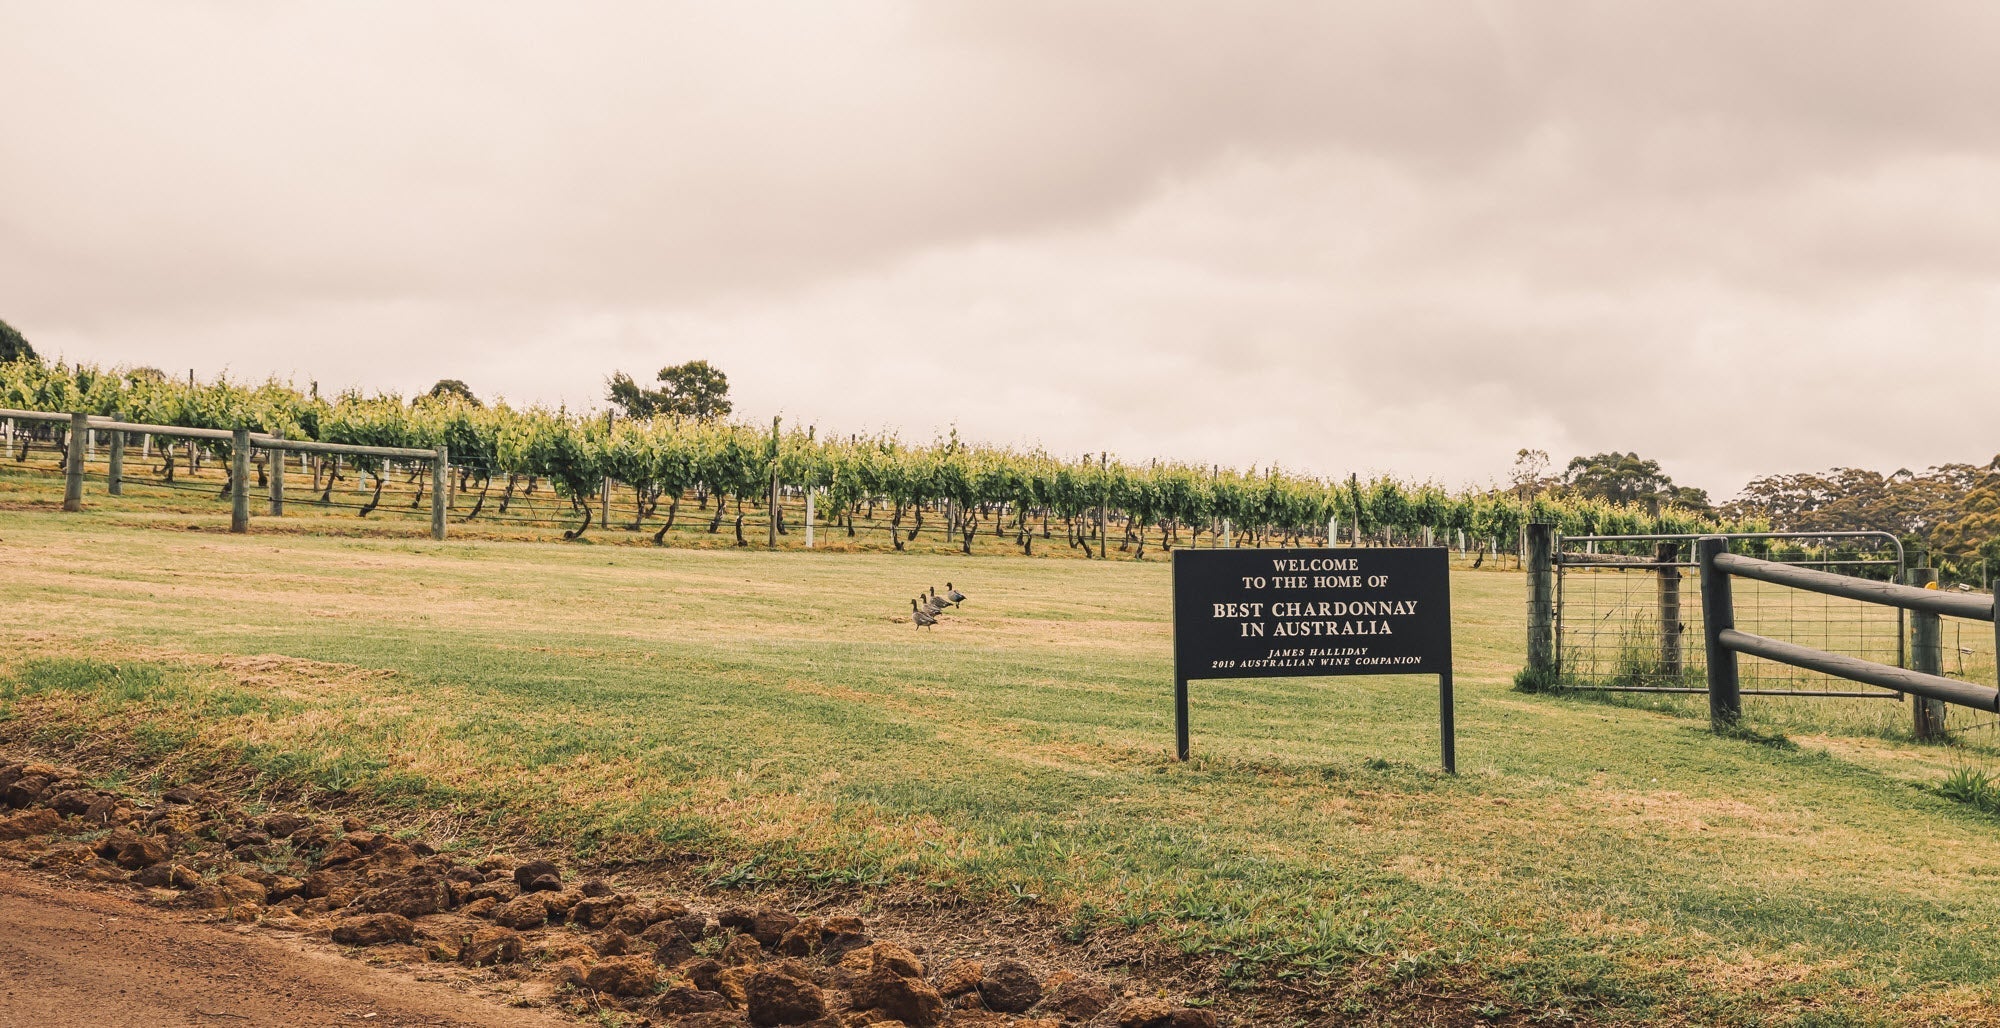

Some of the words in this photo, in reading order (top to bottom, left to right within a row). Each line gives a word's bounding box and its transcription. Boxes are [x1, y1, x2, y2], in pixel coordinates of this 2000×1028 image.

[1273, 559, 1358, 571] WELCOME
[1242, 577, 1266, 588] TO
[1272, 577, 1307, 588] THE
[1314, 576, 1362, 588] HOME
[1368, 576, 1388, 587] OF
[1213, 603, 1263, 617] BEST
[1272, 601, 1417, 617] CHARDONNAY
[1241, 623, 1264, 637] IN
[1273, 620, 1392, 636] AUSTRALIA
[1267, 649, 1305, 659] JAMES
[1310, 647, 1369, 657] HALLIDAY
[1212, 660, 1235, 669] 2019
[1240, 658, 1316, 668] AUSTRALIAN
[1320, 657, 1351, 666] WINE
[1355, 656, 1422, 666] COMPANION
